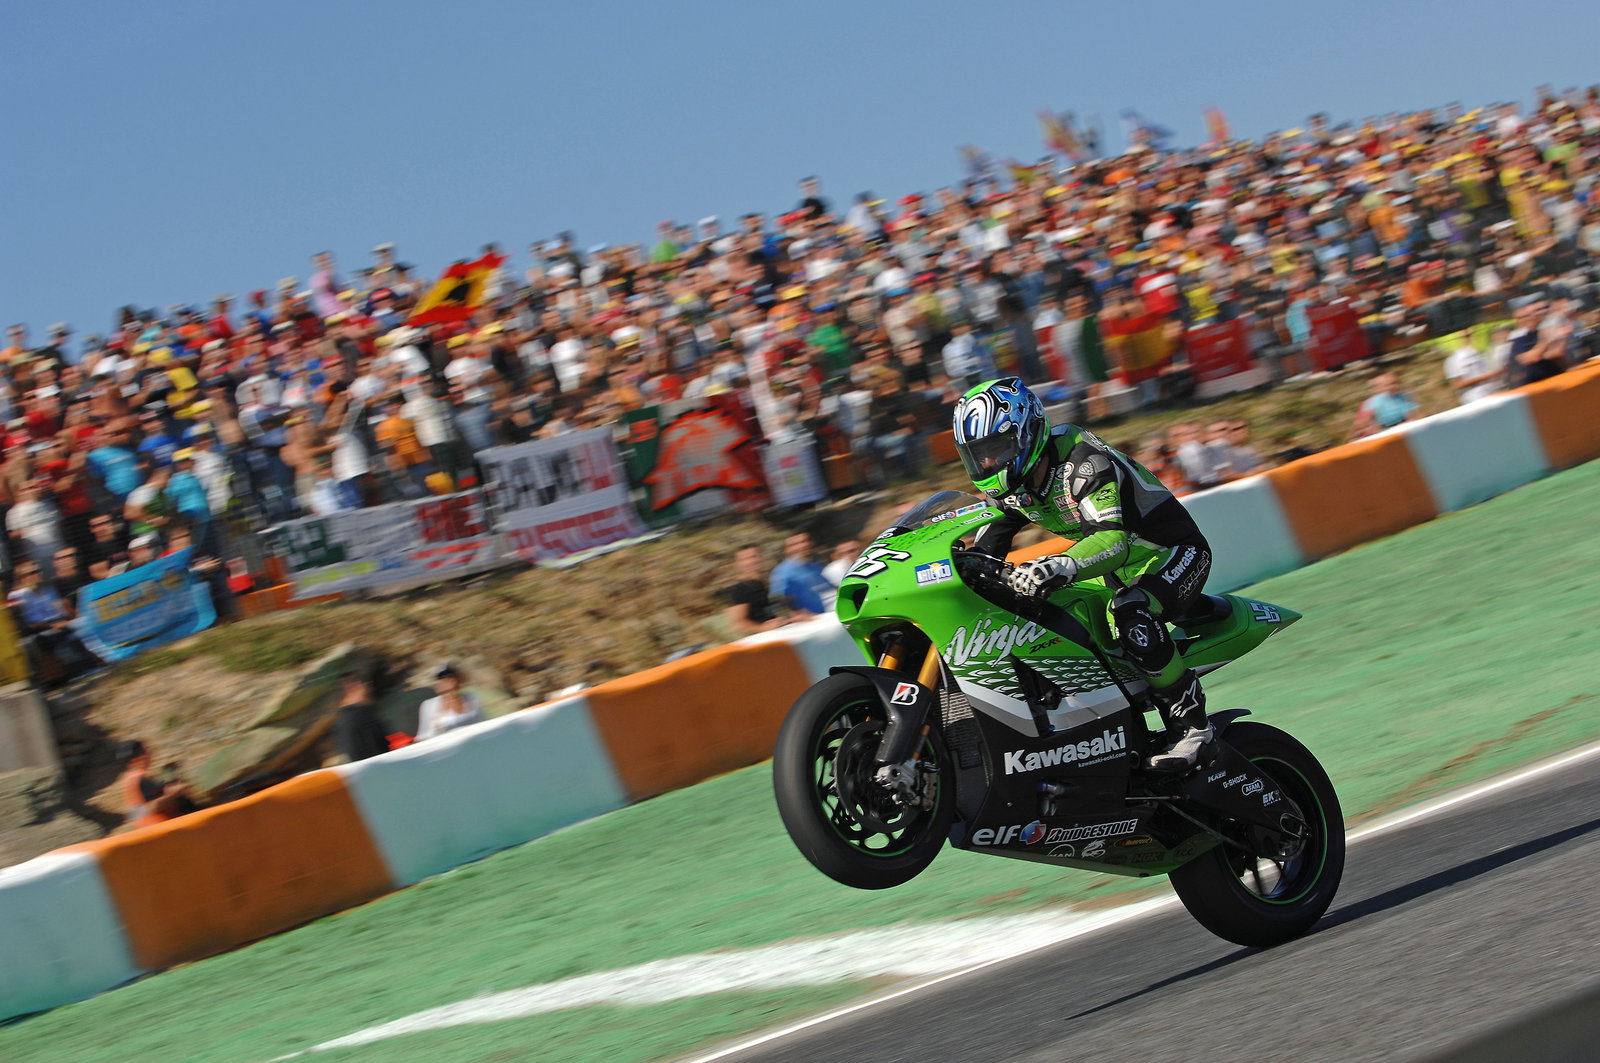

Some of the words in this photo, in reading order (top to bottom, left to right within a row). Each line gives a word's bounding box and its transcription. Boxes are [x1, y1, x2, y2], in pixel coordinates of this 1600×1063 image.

[931, 513, 947, 523] elf
[1077, 540, 1125, 569] Kawasaki
[943, 615, 1047, 669] Ninja
[1003, 725, 1127, 775] Kawasaki
[1222, 773, 1248, 789] G-SHOCK
[971, 824, 1022, 846] elf
[1045, 818, 1138, 845] BRIDGESTONE
